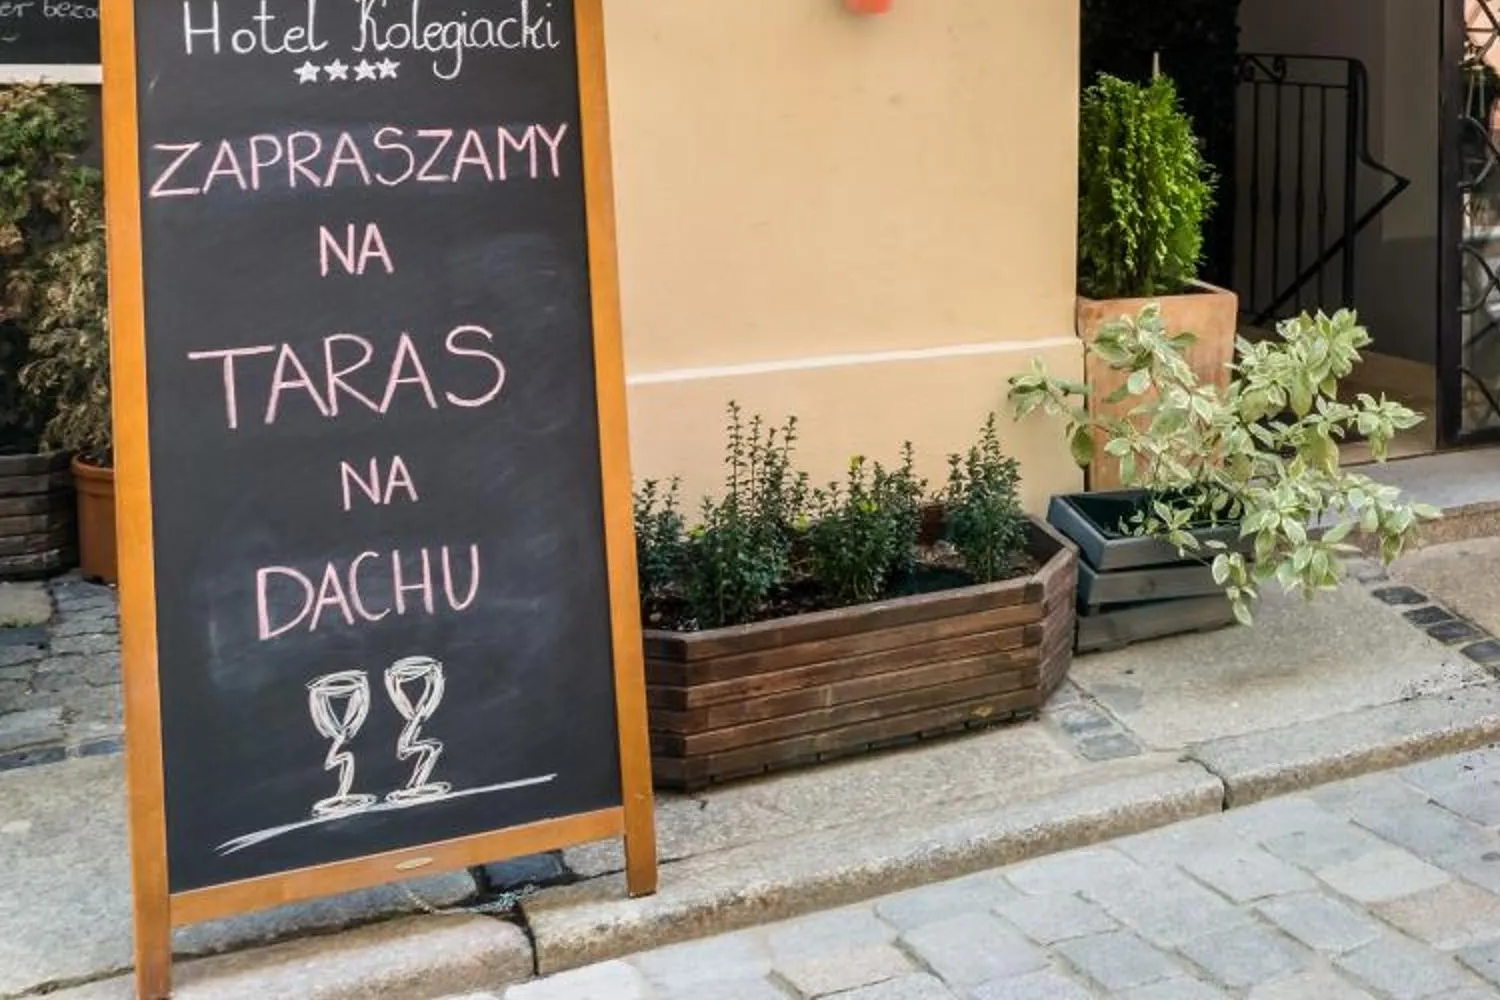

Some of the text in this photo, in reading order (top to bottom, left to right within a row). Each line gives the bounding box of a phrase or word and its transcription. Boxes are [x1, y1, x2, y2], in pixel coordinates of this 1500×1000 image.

[148, 122, 569, 199] ZAPRASZAMY
[319, 223, 393, 277] NA
[188, 325, 506, 429] TARAS
[340, 455, 418, 511] NA
[256, 544, 480, 641] DACHU
